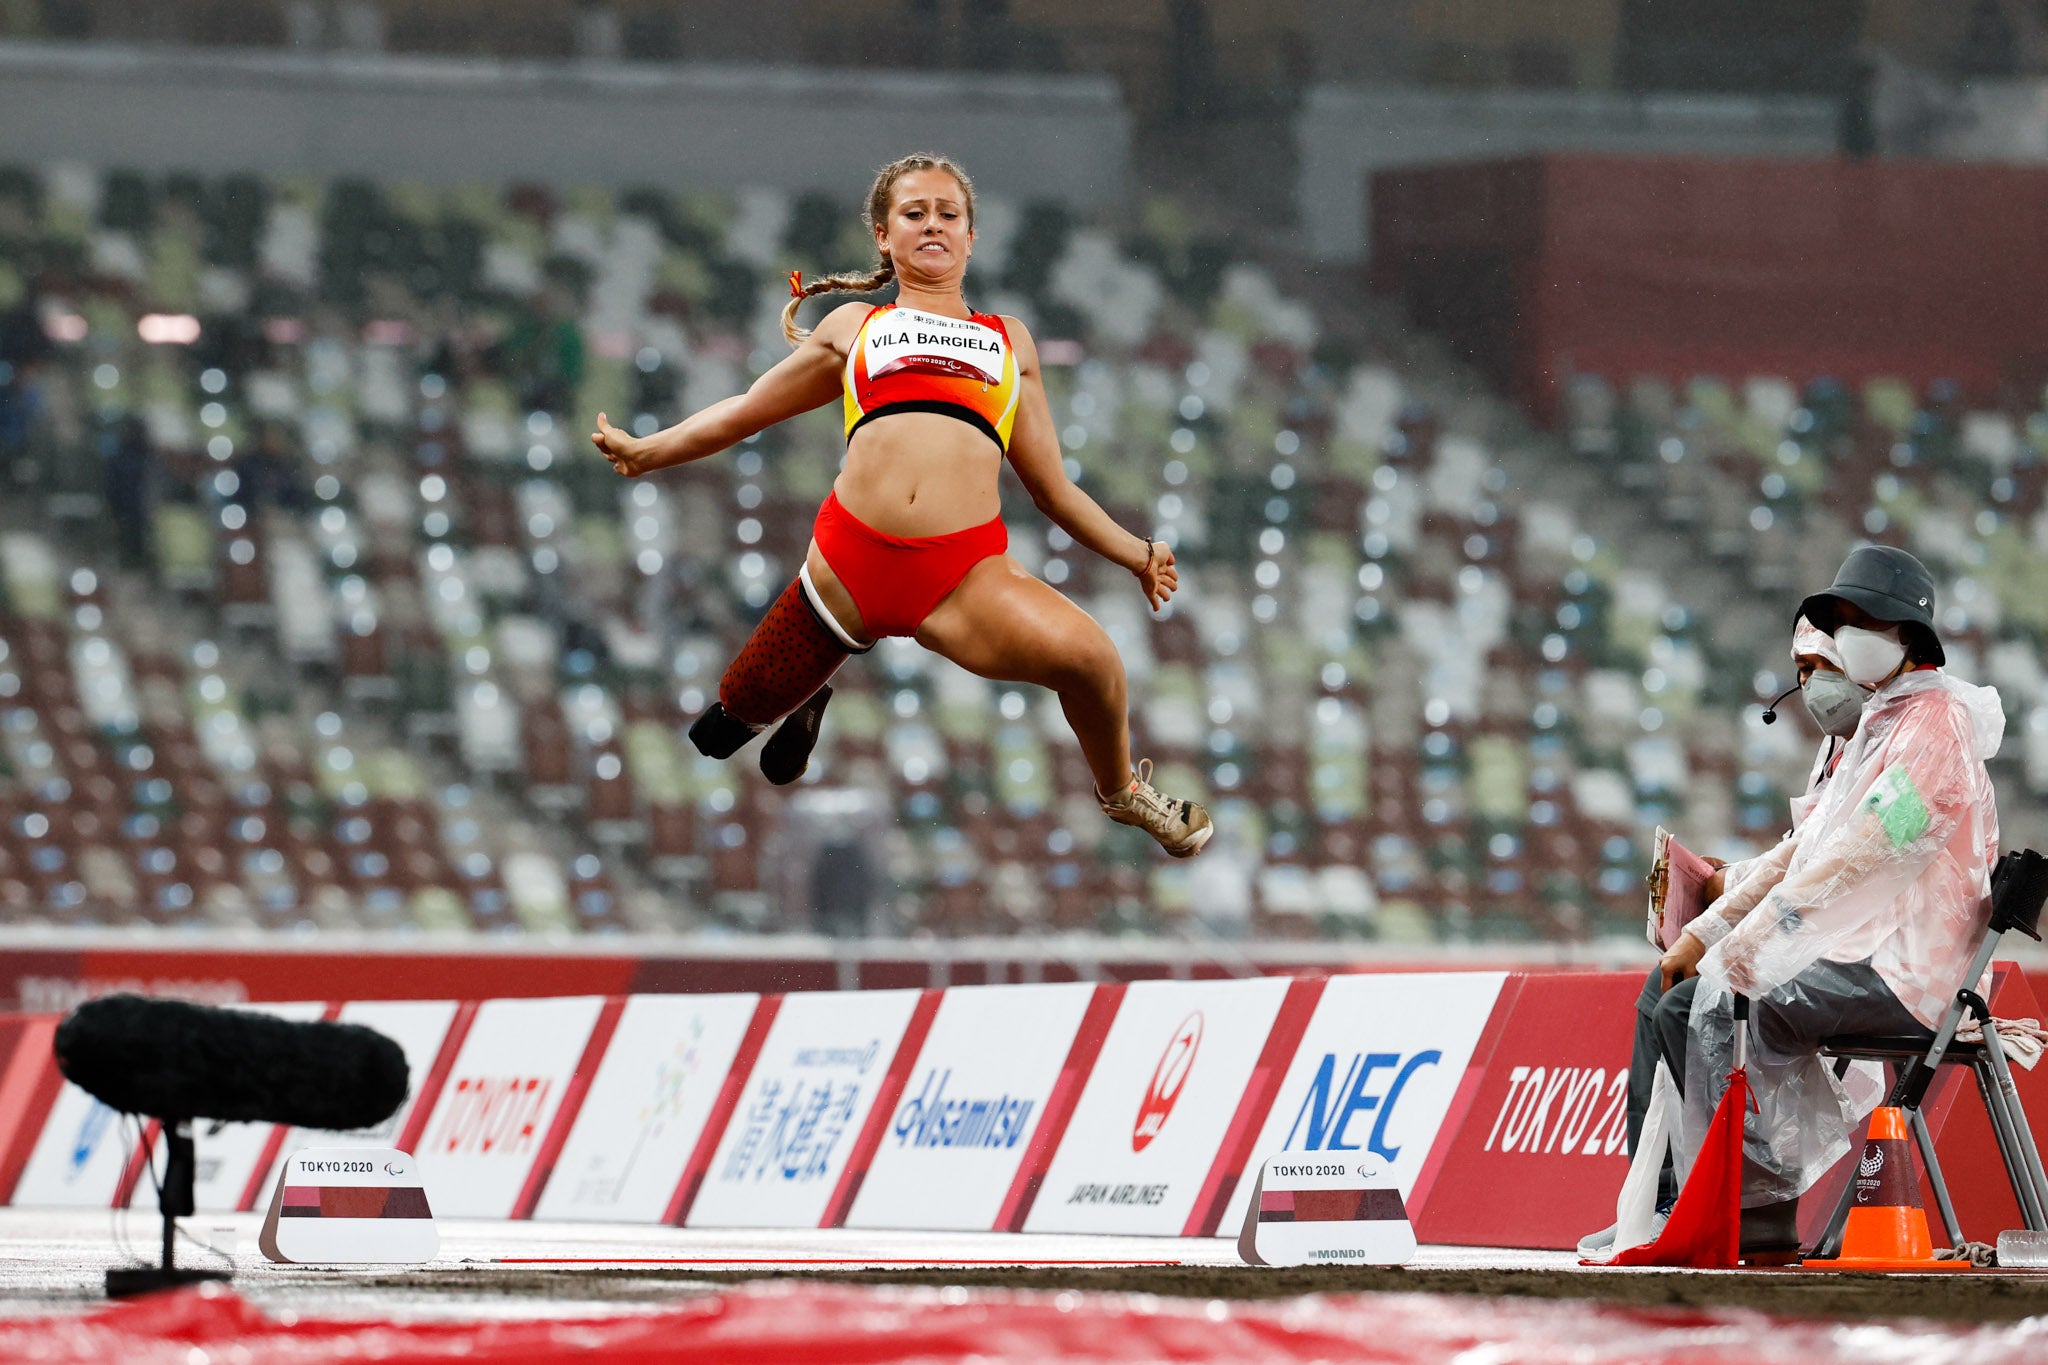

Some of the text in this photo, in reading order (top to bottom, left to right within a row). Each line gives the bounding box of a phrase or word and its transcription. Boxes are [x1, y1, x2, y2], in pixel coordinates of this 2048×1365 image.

[872, 332, 1000, 354] VILA BARGIELA
[930, 357, 946, 365] 2020
[432, 1078, 553, 1153] TOYOTA
[895, 1068, 1034, 1148] Hisamitsu
[1282, 1050, 1442, 1163] NEC
[1484, 1066, 1629, 1156] TOKYO 20
[300, 1161, 374, 1173] TOKYO 2020
[1273, 1165, 1346, 1176] TOKYO 2020
[1866, 1179, 1881, 1187] 2020
[1066, 1183, 1169, 1206] JAPAN AIRLINES
[1317, 1249, 1366, 1259] MONDO
